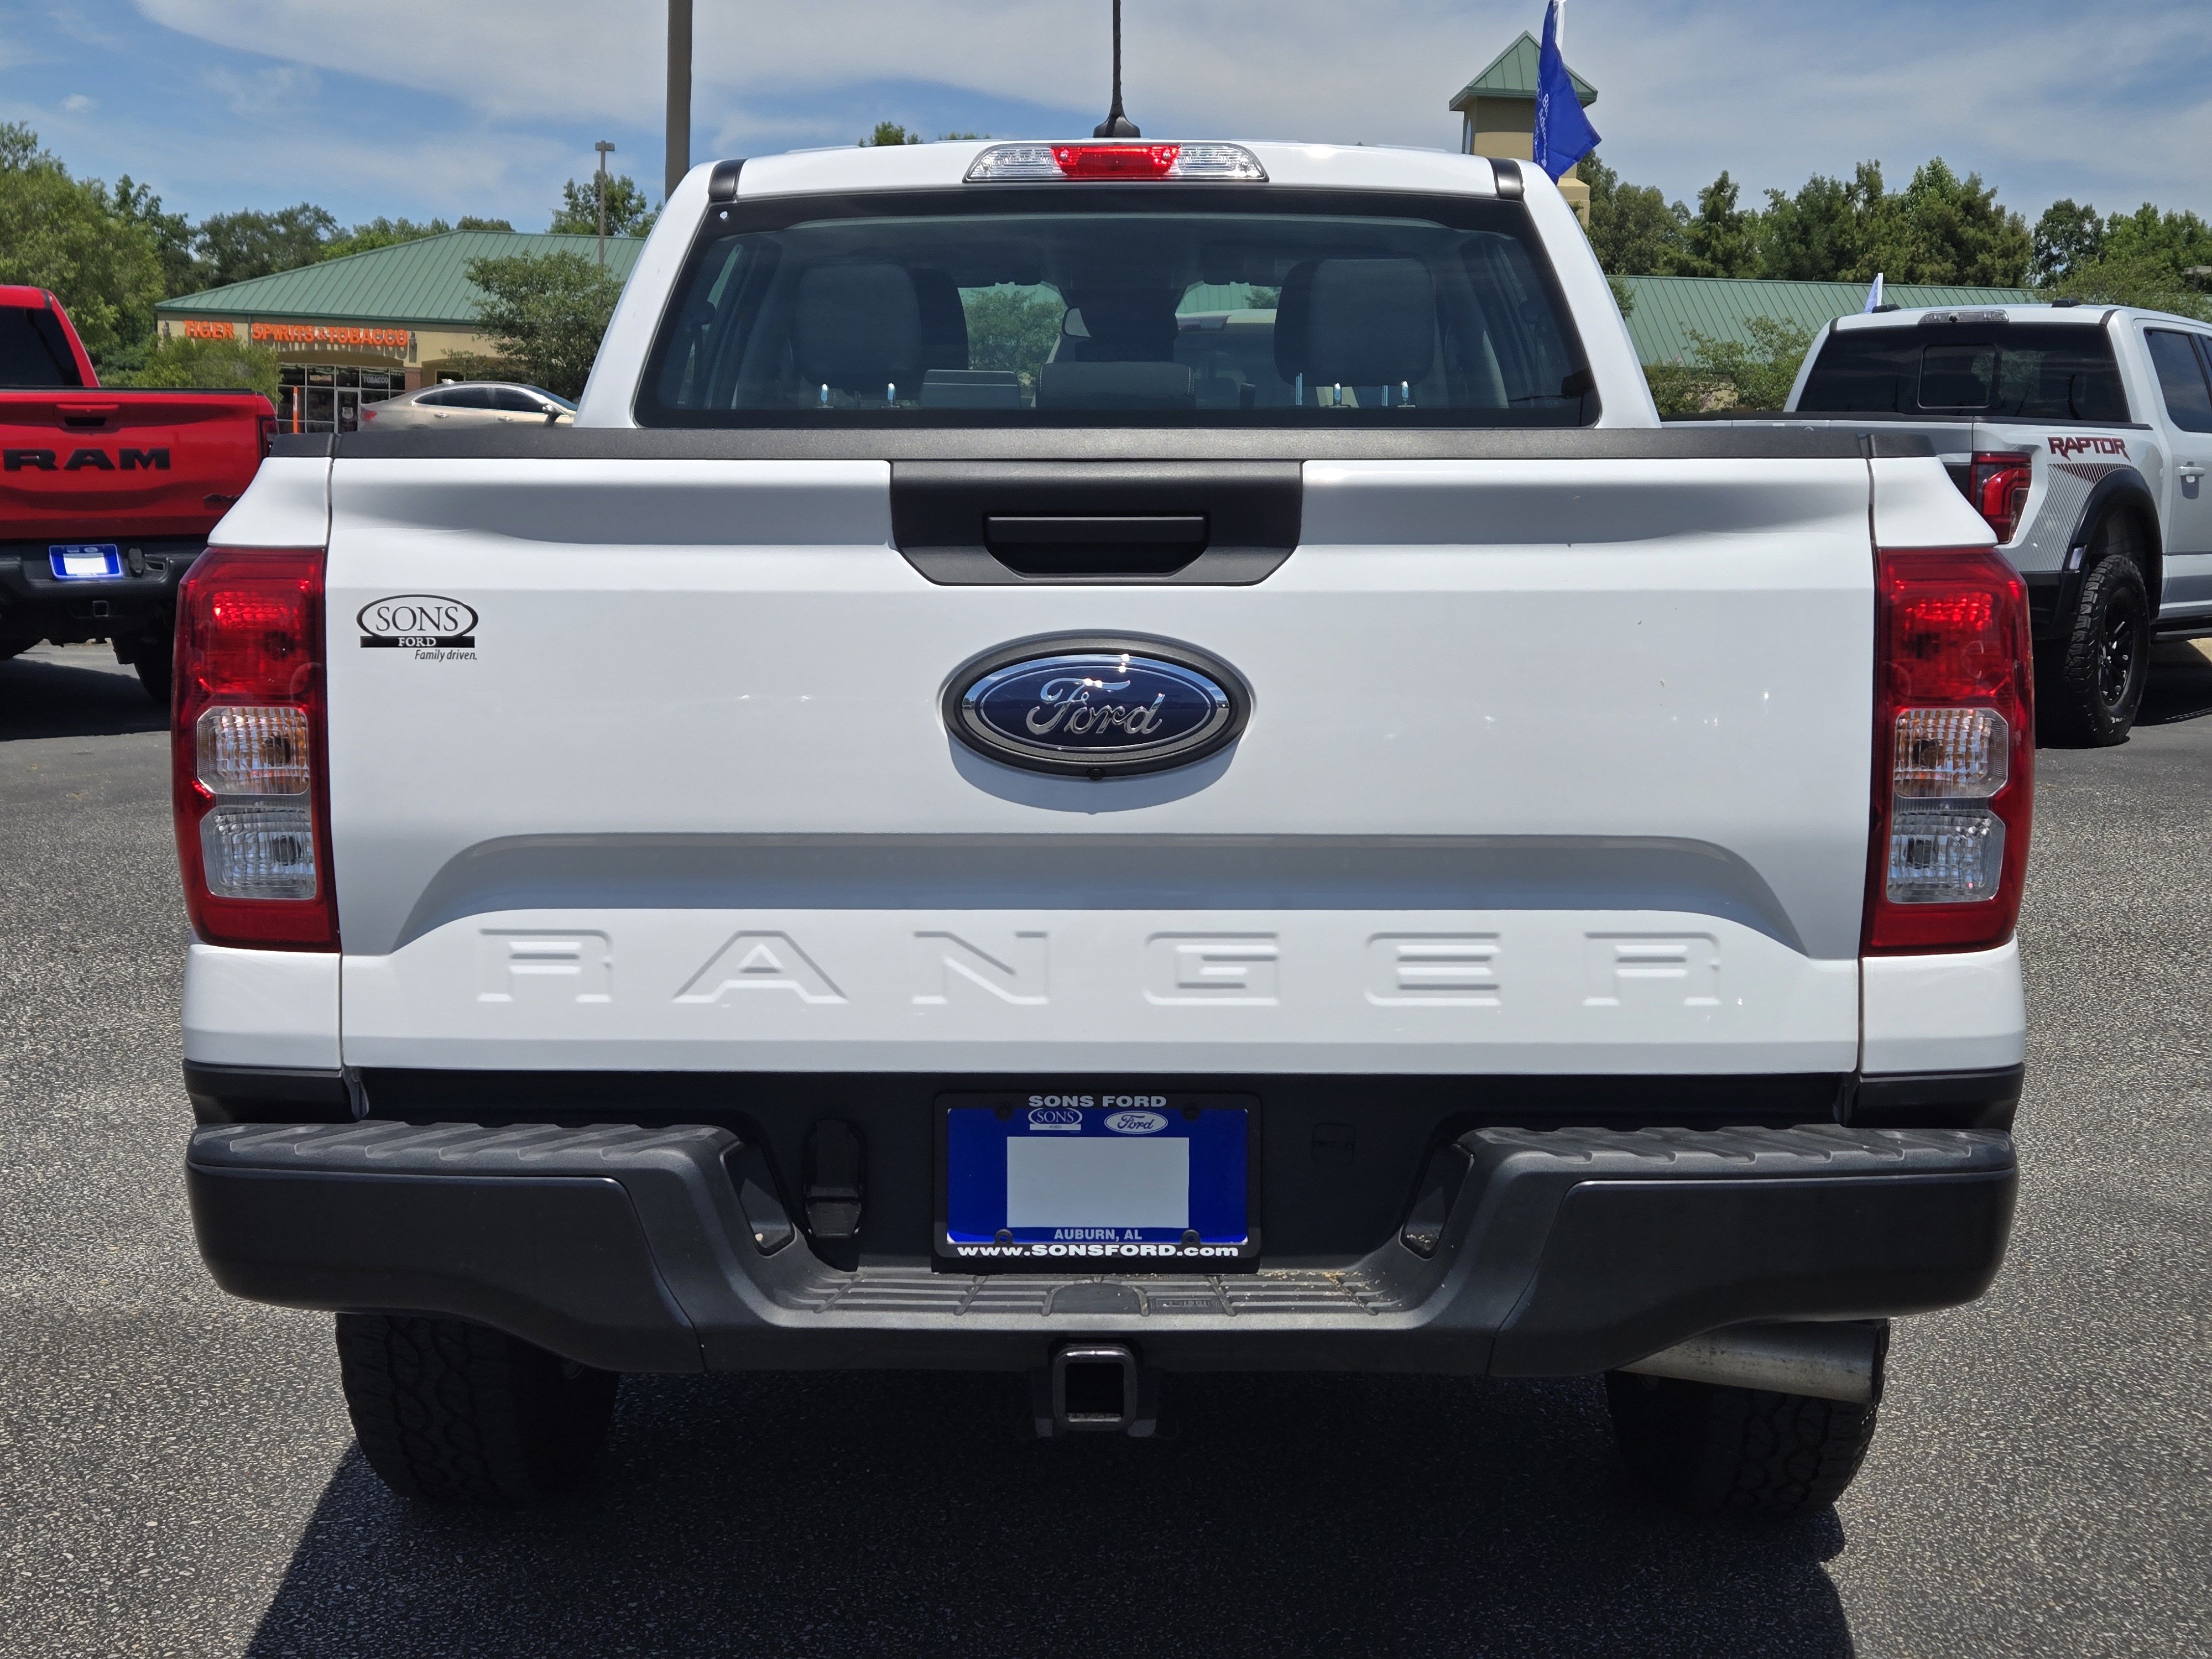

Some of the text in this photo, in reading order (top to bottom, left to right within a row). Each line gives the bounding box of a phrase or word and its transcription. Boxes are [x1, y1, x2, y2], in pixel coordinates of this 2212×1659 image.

[183, 320, 408, 346] TIGER SPIRITS & TOBACCO
[363, 375, 389, 384] TOBACCO
[2047, 436, 2131, 462] RAPTOR
[3, 448, 171, 471] RAM
[375, 606, 458, 632] SONS
[398, 637, 436, 646] FORD
[414, 649, 477, 662] Family driven.
[1026, 677, 1166, 734] Ford
[477, 928, 1721, 1008] RANGER
[1029, 1095, 1167, 1107] SONS FORD
[1037, 1111, 1074, 1123] SONS
[1117, 1114, 1154, 1130] Ford
[1054, 1229, 1142, 1241] AUBURN, AL
[957, 1244, 1239, 1256] www.SONSFORD.com
